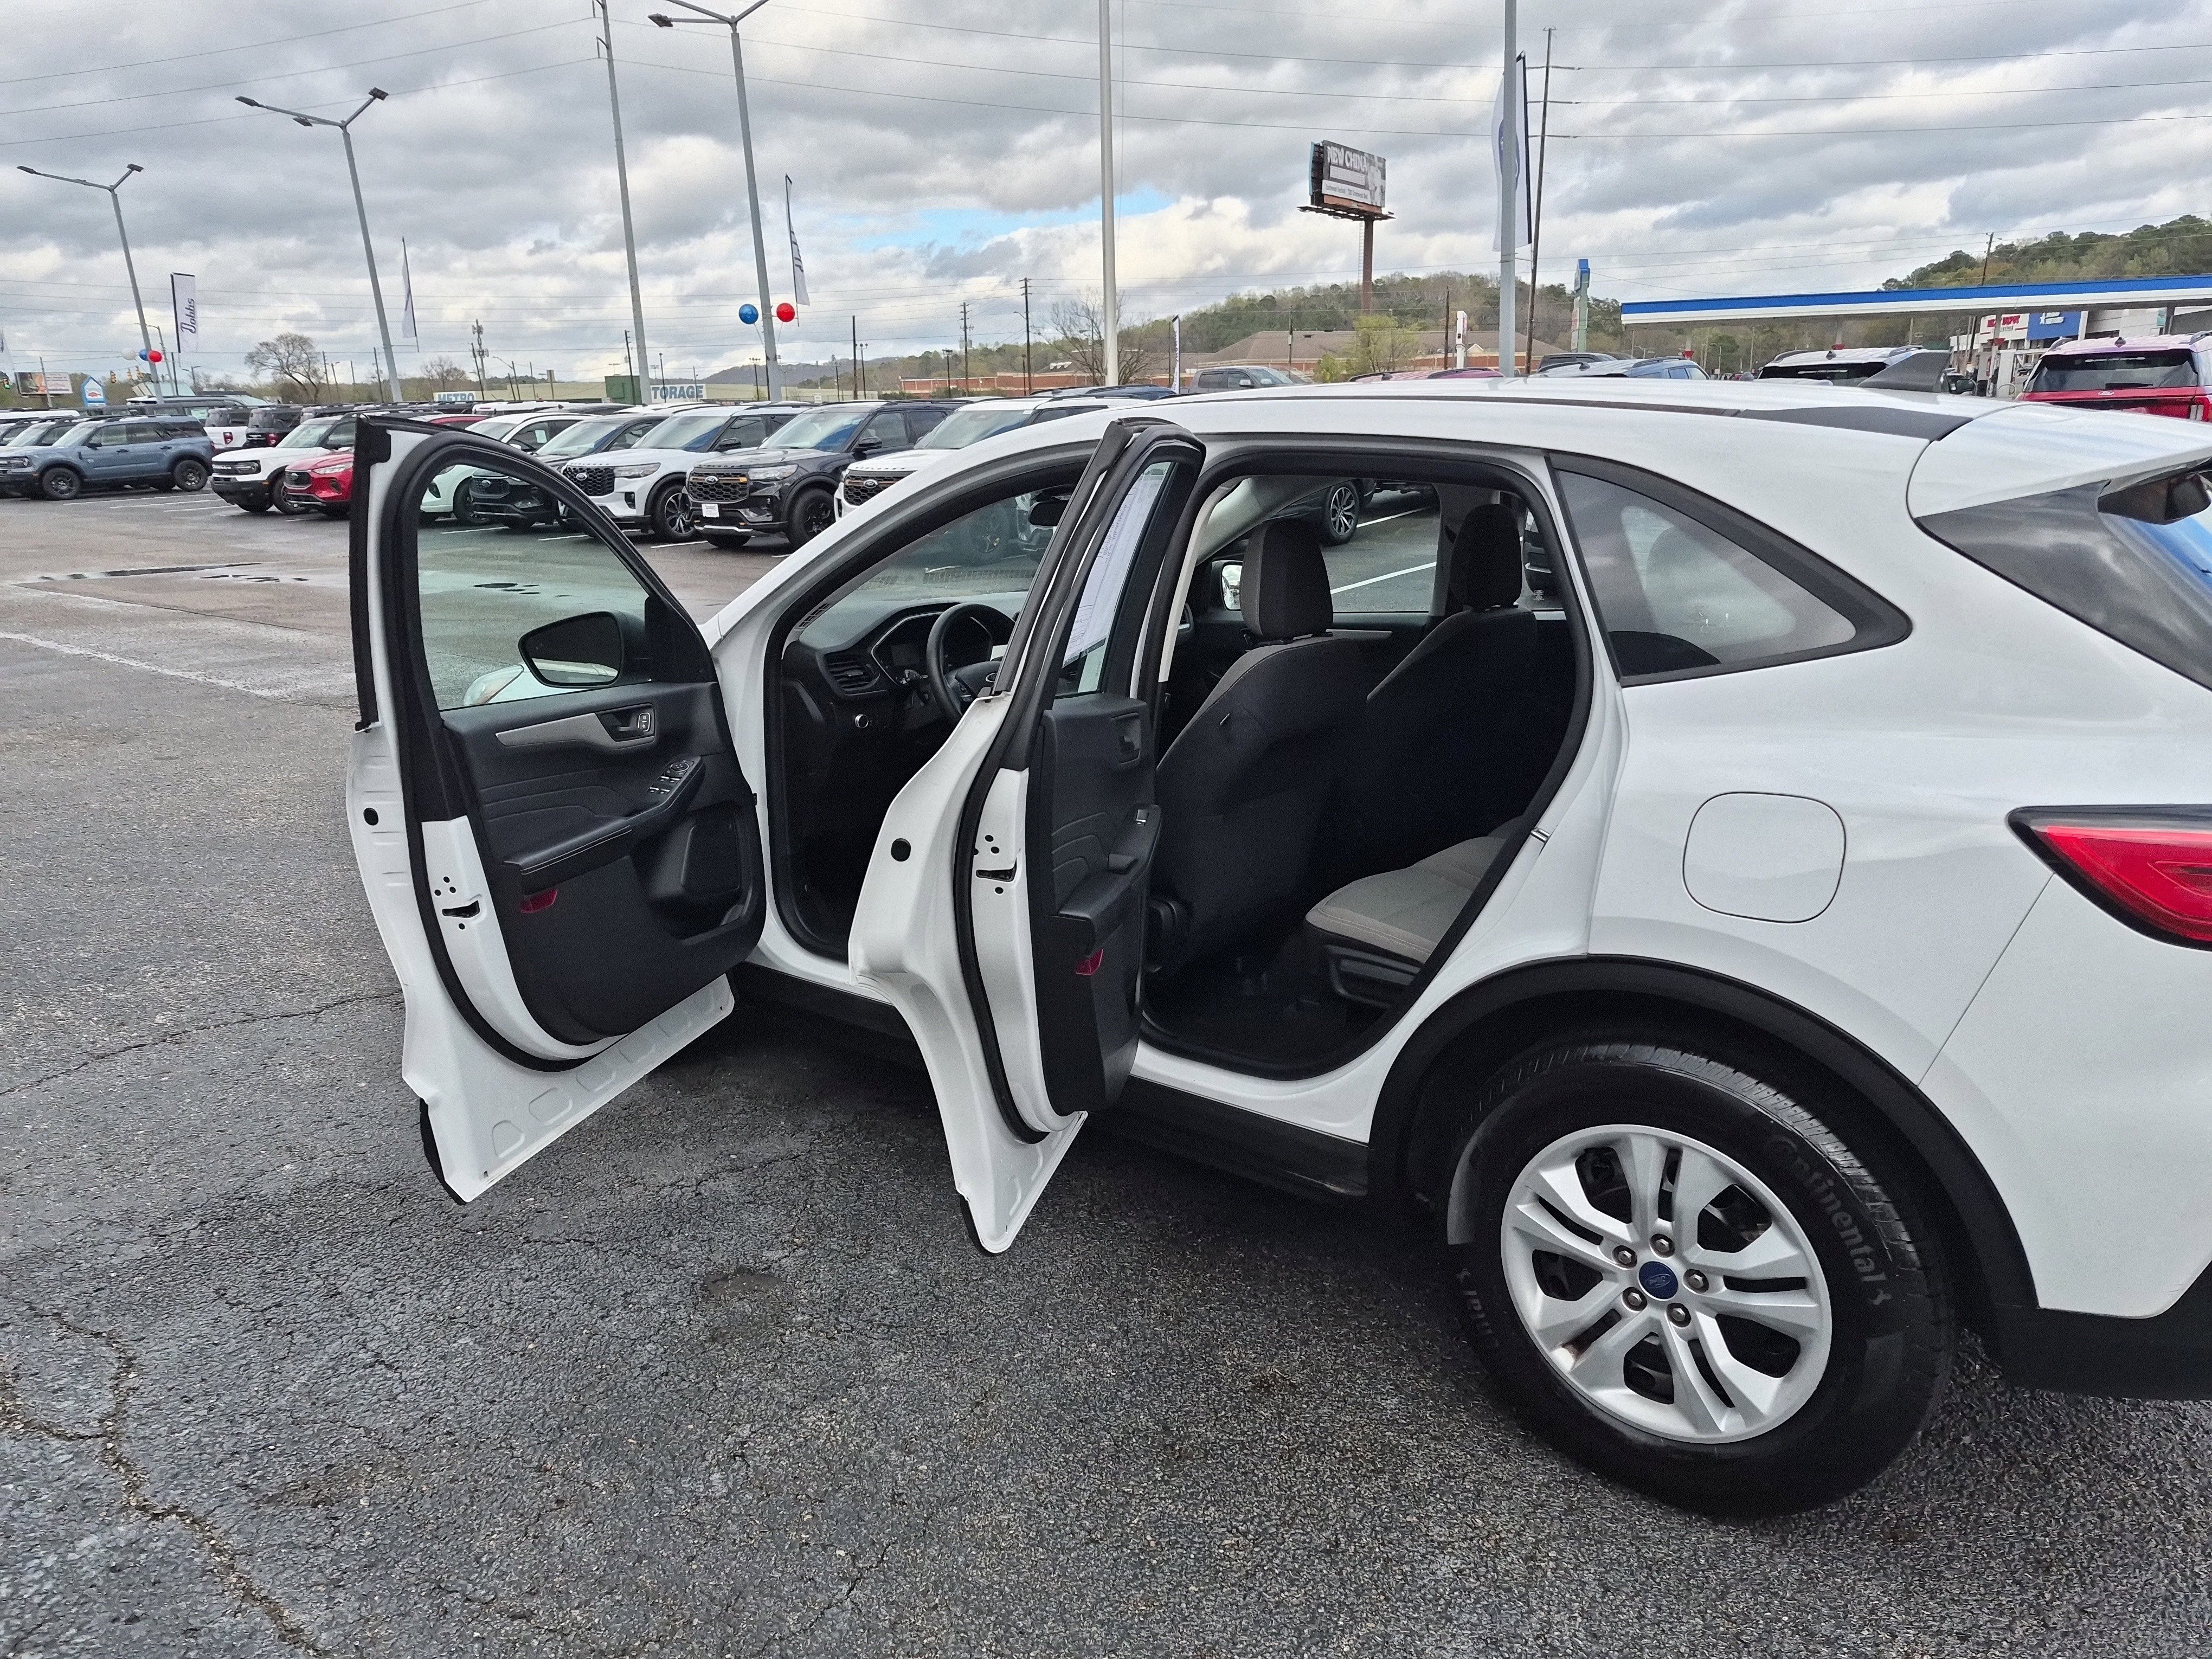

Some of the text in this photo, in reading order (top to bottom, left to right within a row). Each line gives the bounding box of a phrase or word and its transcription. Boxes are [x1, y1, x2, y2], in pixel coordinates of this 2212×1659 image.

[1327, 145, 1368, 172] NEW CHINA
[180, 297, 196, 334] Dobbs
[438, 393, 474, 401] METRO
[652, 385, 704, 399] TORAGE
[1764, 1134, 1887, 1282] Continental
